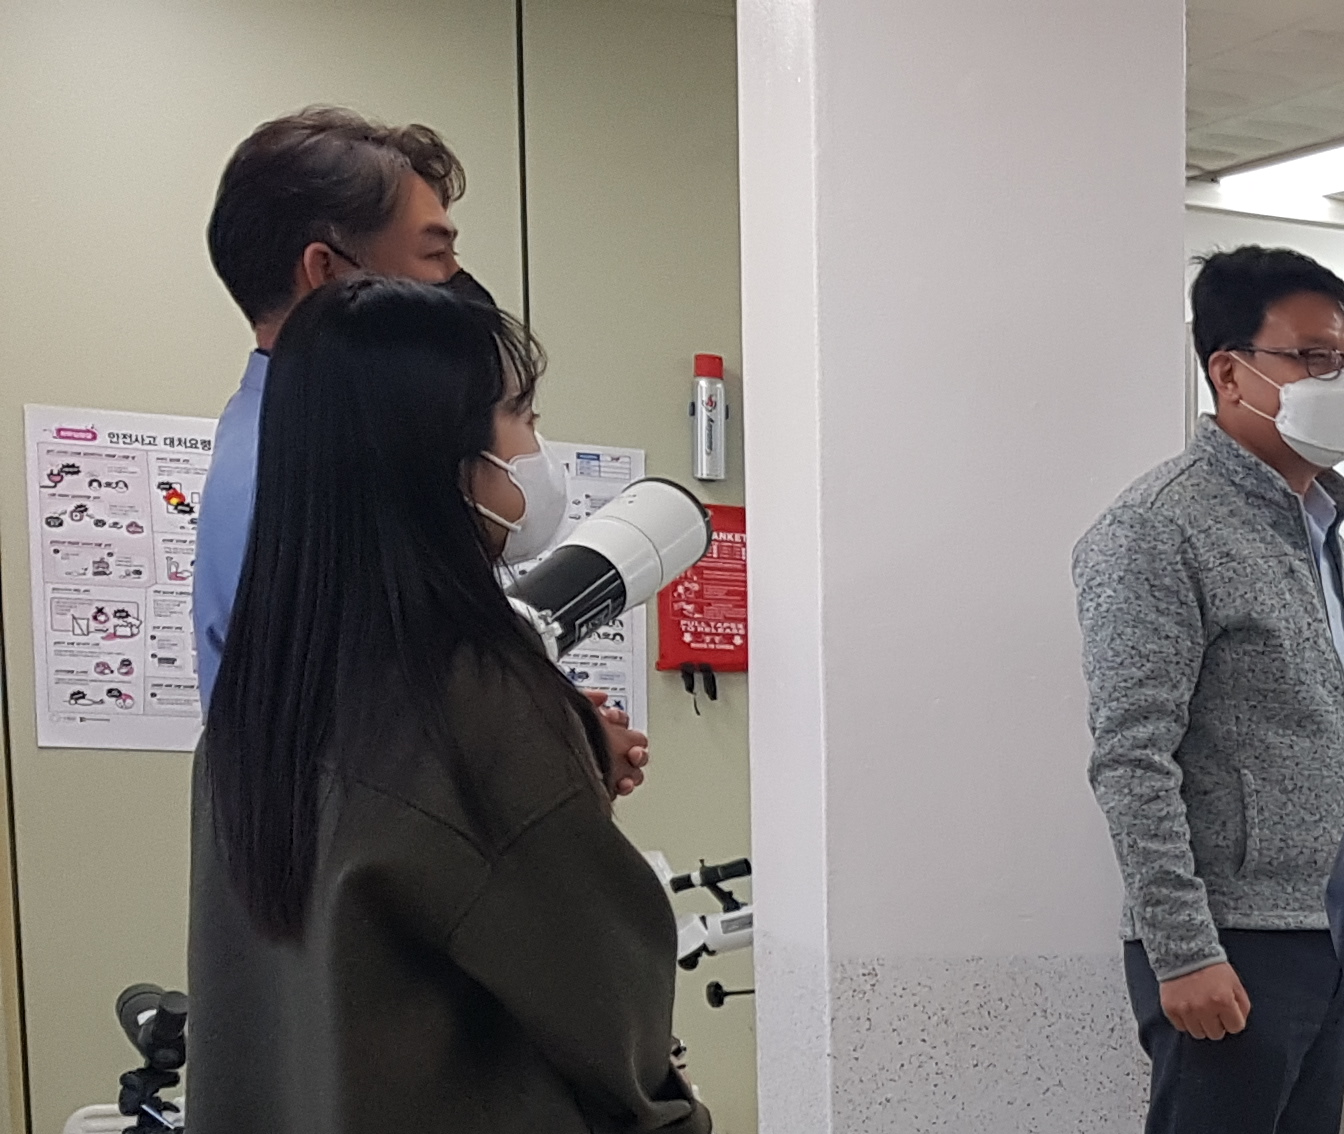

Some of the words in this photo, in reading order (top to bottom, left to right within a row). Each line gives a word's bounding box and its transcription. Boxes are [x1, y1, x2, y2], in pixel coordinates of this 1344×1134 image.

[107, 431, 158, 447] 안전사고
[163, 436, 212, 451] 대처요령
[712, 531, 746, 543] ANKET
